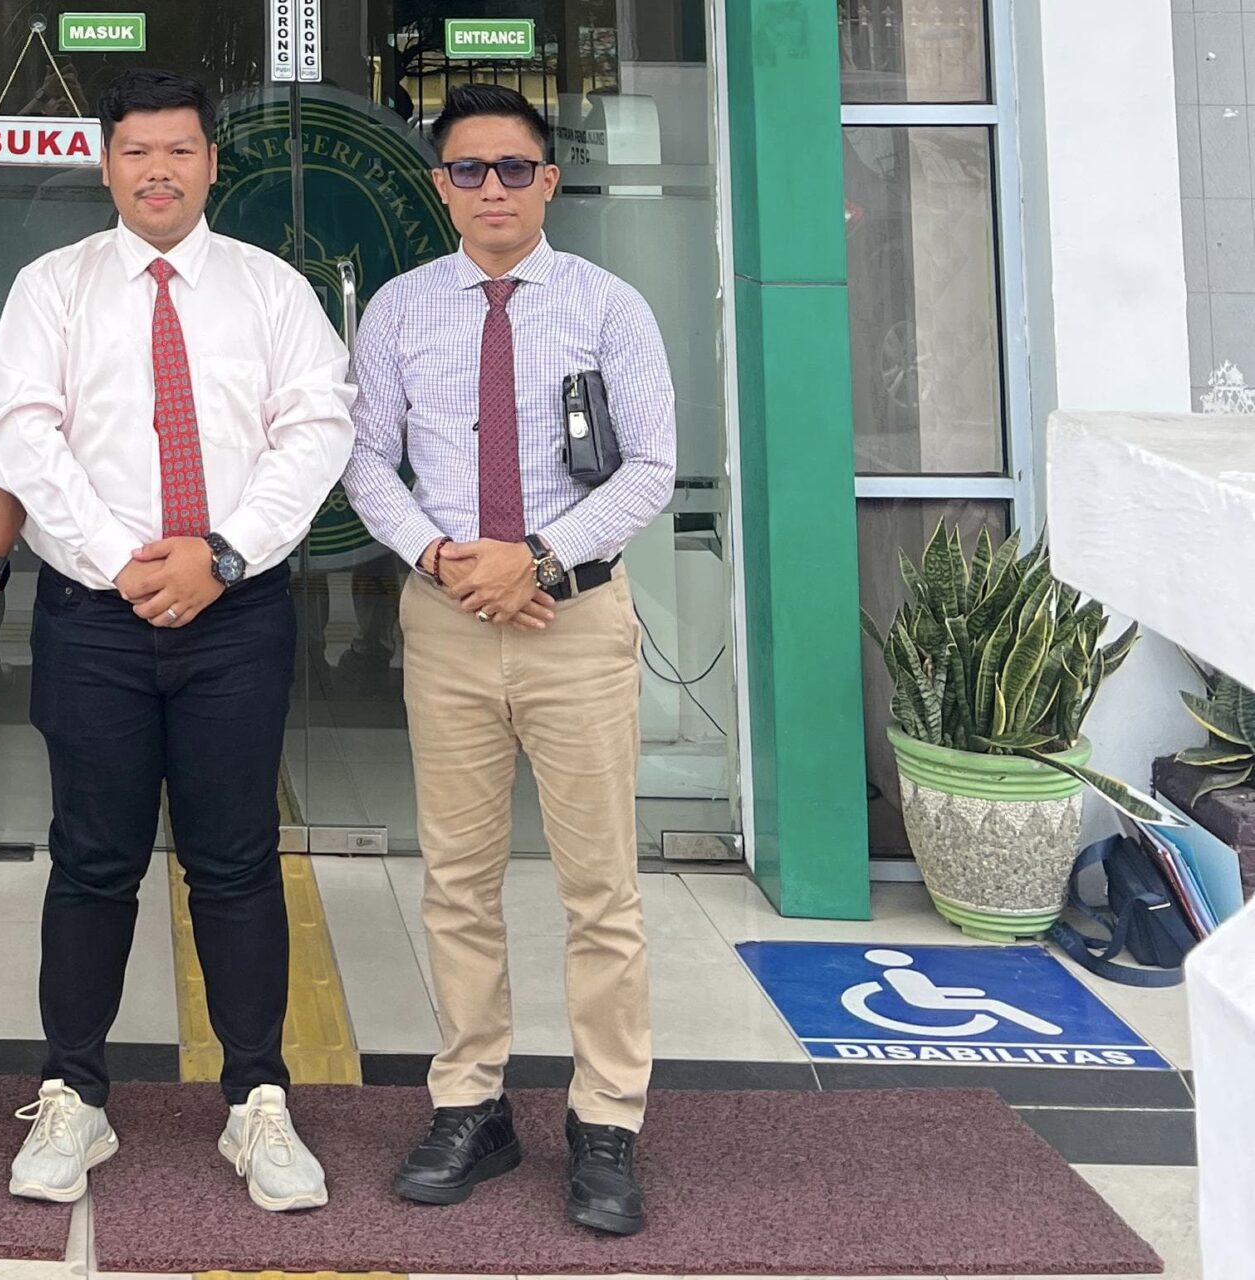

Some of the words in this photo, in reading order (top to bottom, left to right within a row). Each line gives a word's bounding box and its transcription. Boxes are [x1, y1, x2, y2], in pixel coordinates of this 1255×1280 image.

[69, 26, 134, 40] MASUK
[454, 30, 525, 45] ENTRANCE
[241, 132, 364, 169] NEGERI
[836, 1044, 1136, 1065] DISABILITAS
